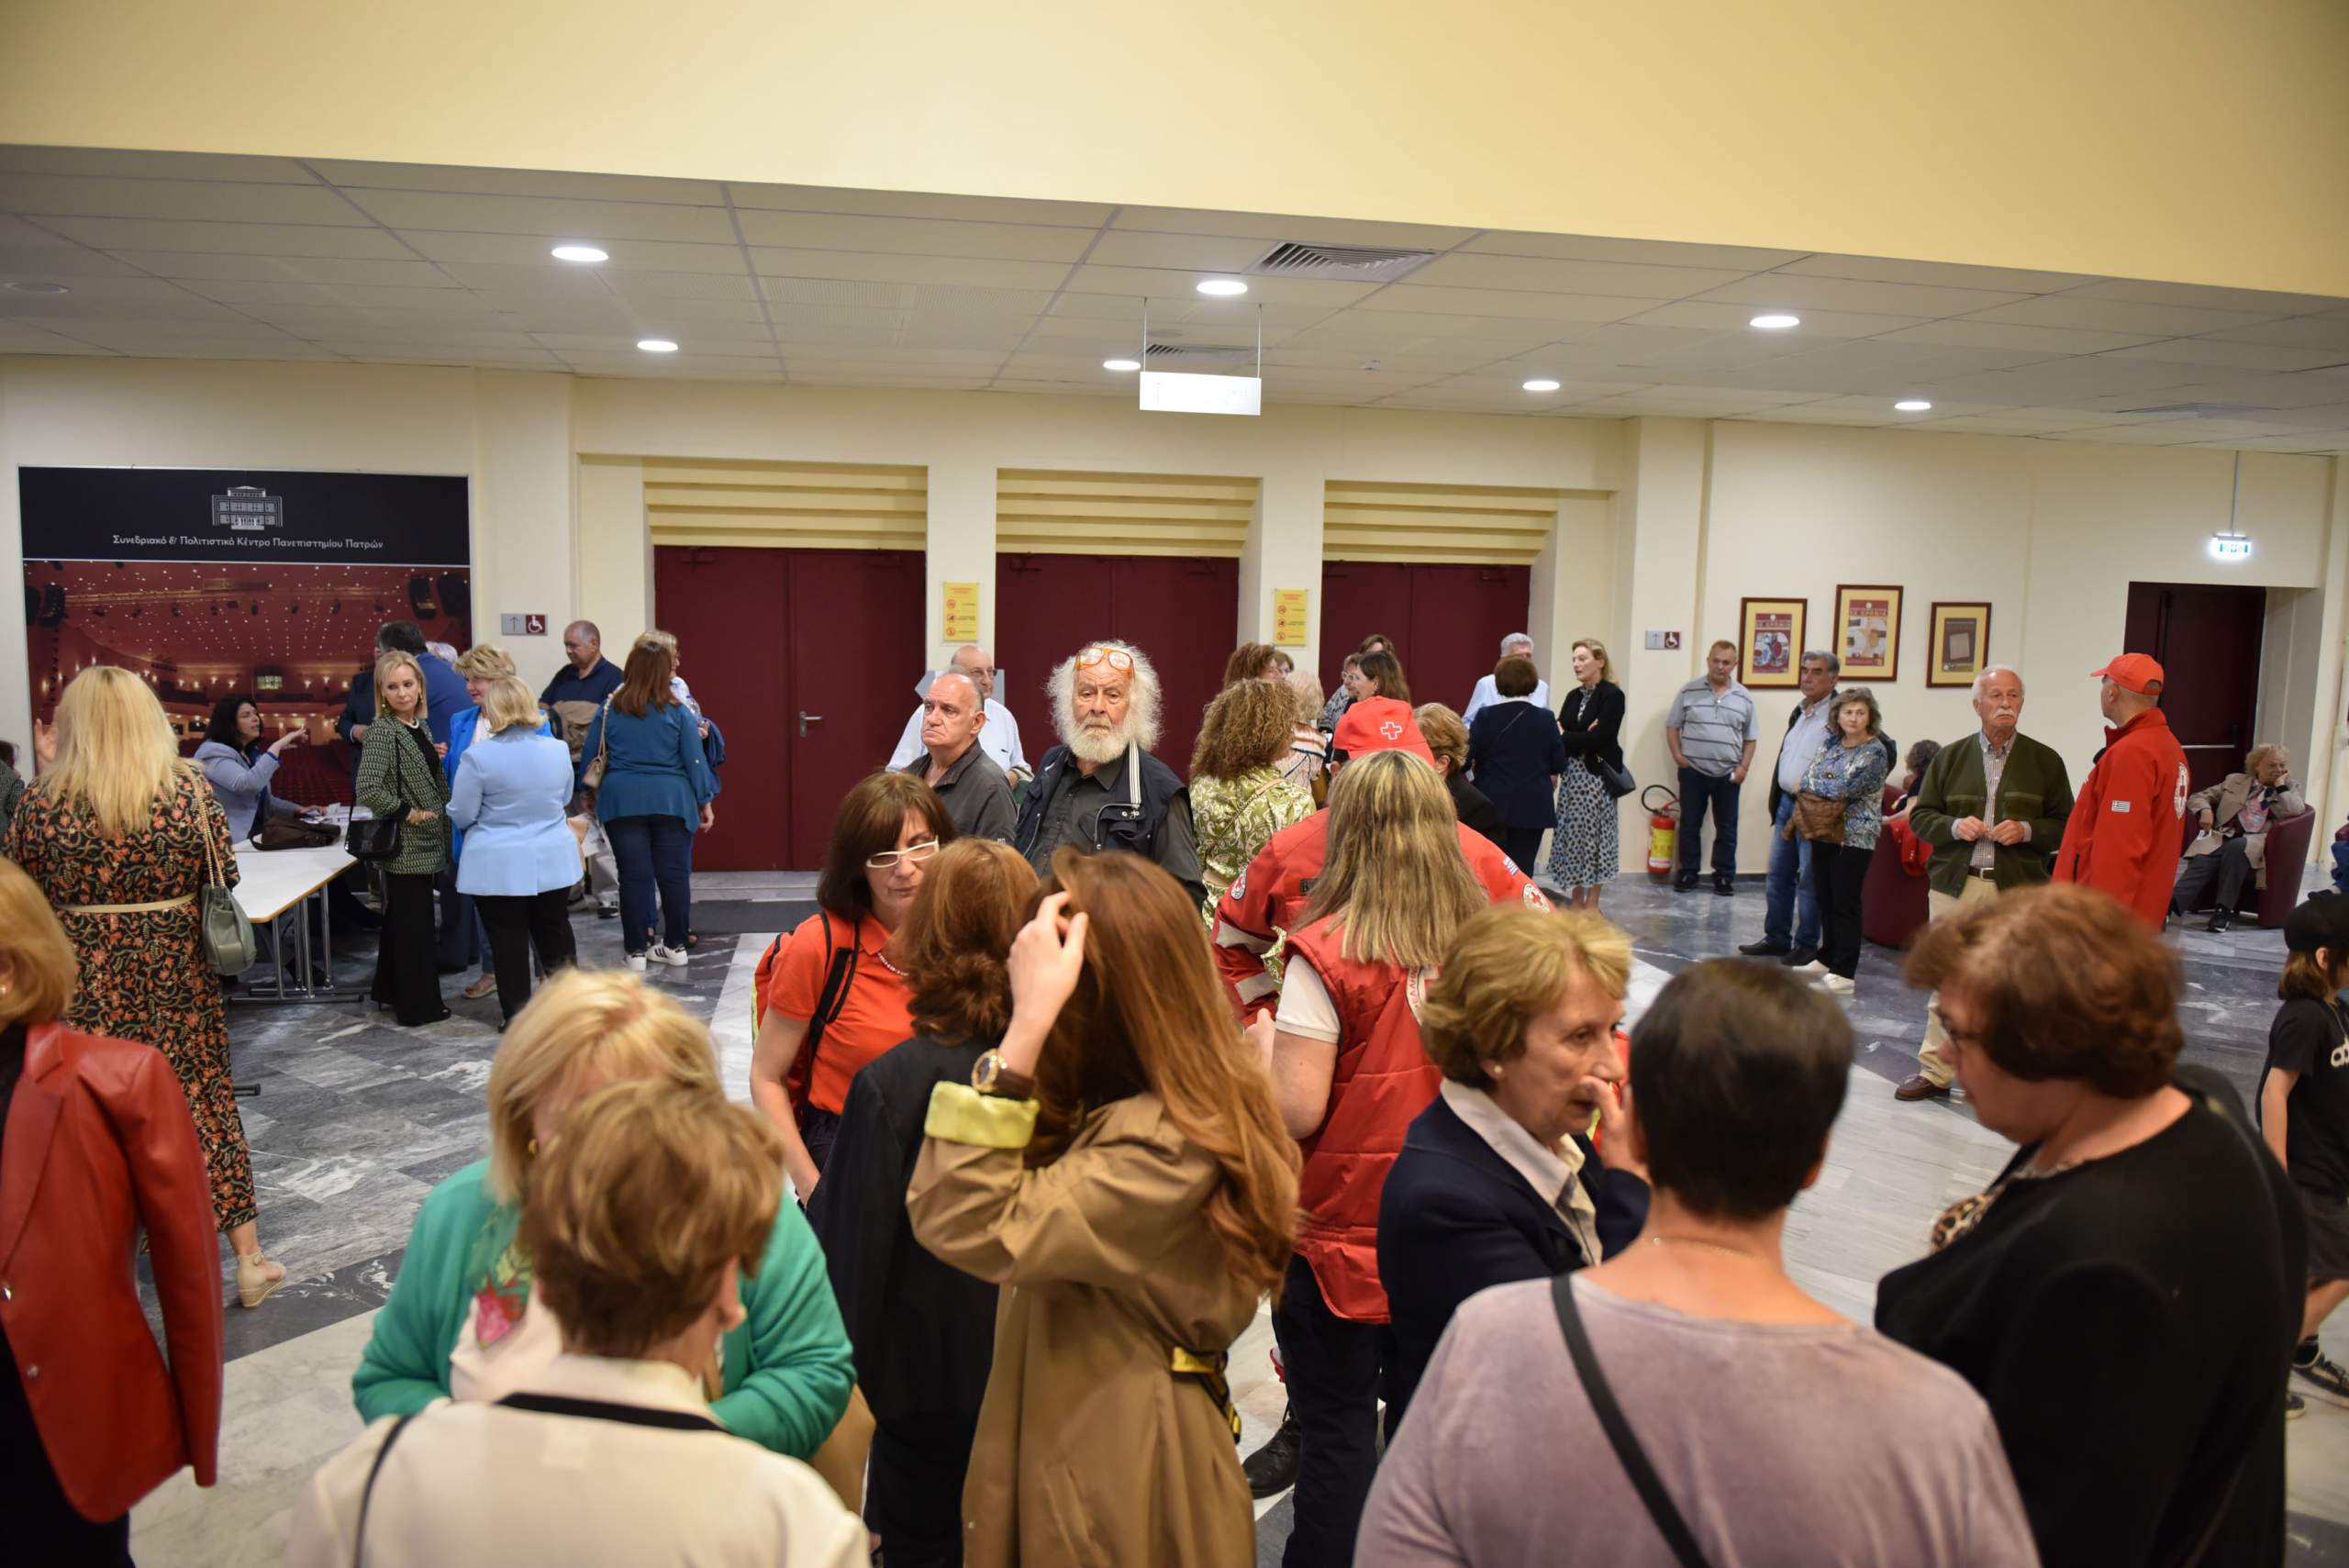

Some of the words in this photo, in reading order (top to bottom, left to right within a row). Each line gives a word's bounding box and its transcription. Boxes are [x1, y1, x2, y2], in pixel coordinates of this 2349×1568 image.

[112, 534, 167, 546] Συνεδριακό
[169, 536, 178, 545] &
[180, 536, 235, 545] Πολιτιστικό
[237, 537, 271, 548] Κέντρο
[273, 538, 343, 549] Πανεπιστημίου
[346, 539, 384, 550] Πατρών
